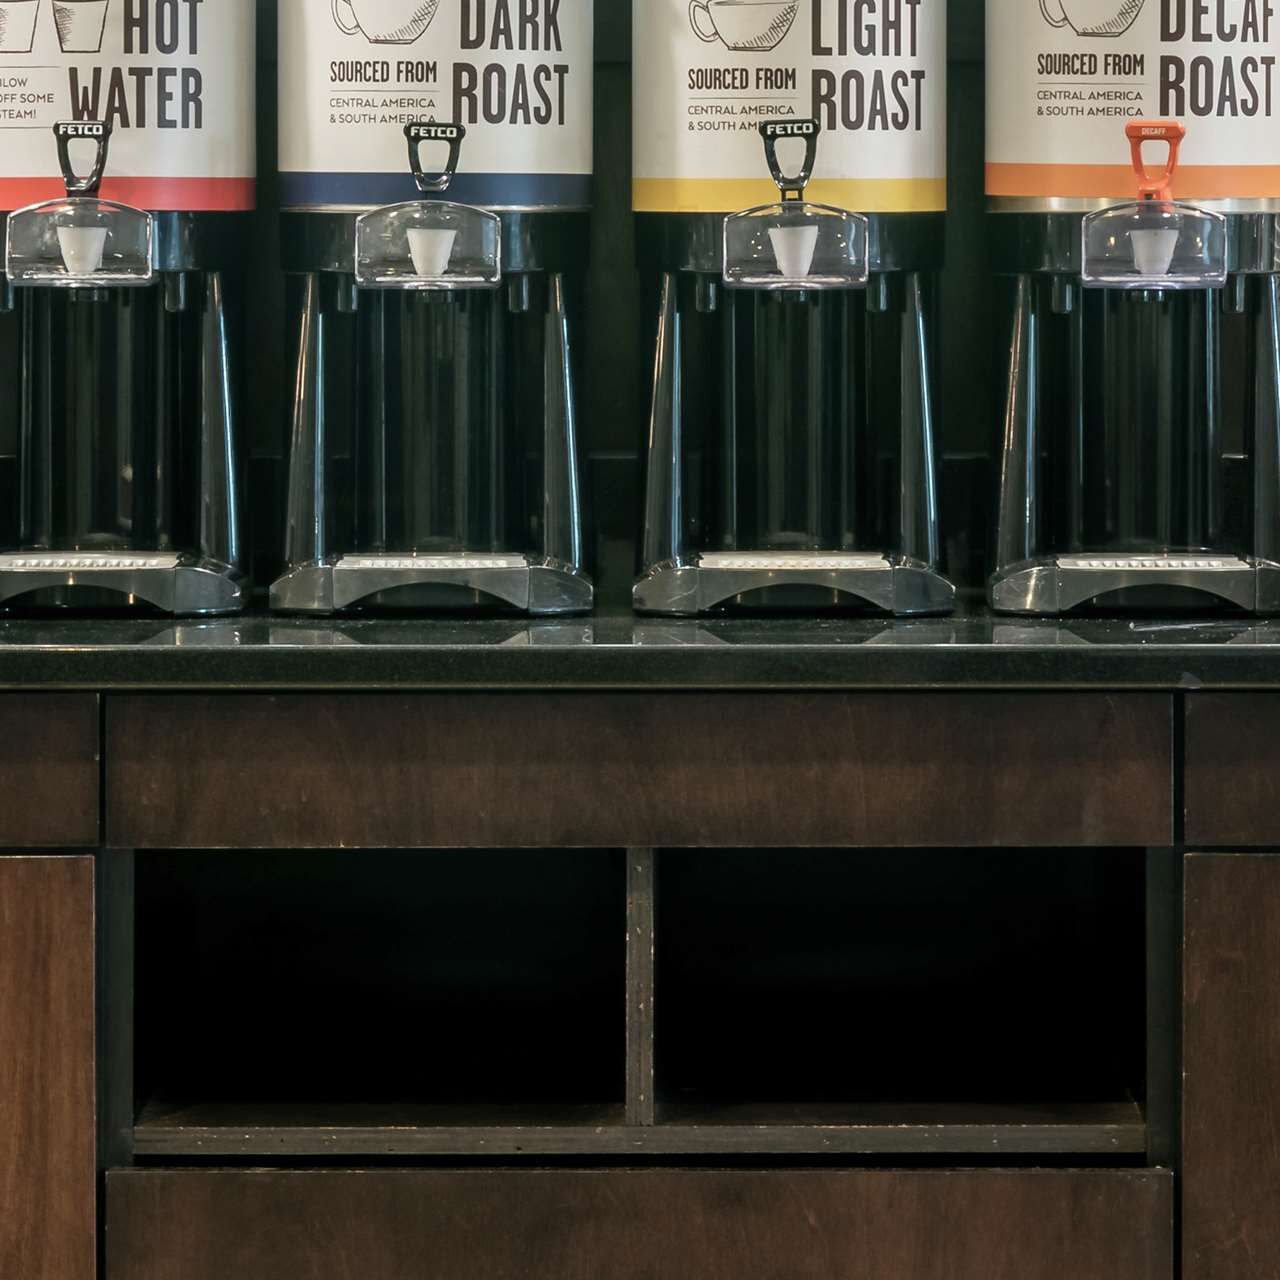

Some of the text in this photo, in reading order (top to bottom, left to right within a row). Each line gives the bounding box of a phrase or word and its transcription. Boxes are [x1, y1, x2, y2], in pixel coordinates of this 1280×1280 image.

[1037, 53, 1145, 76] SOURCED FROM
[330, 61, 437, 83] SOURCED FROM
[688, 68, 796, 91] SOURCED FROM
[1159, 55, 1276, 117] ROAST
[20, 93, 54, 104] SOME
[68, 67, 204, 129] WATER
[452, 63, 569, 125] ROAST
[1037, 90, 1143, 101] CENTRAL AMERICA
[329, 98, 436, 109] CENTRAL AMERICA
[811, 70, 926, 131] ROAST
[688, 105, 795, 116] CENTRAL AMERICA
[1037, 106, 1144, 117] & SOUTH AMERICA
[329, 114, 437, 124] & SOUTH AMERICA
[59, 124, 103, 135] FETCO
[688, 121, 695, 131] &
[697, 121, 736, 131] SOUTH
[766, 123, 814, 135] FETCO
[1141, 127, 1166, 136] DECAFF
[410, 126, 457, 138] FETCO
